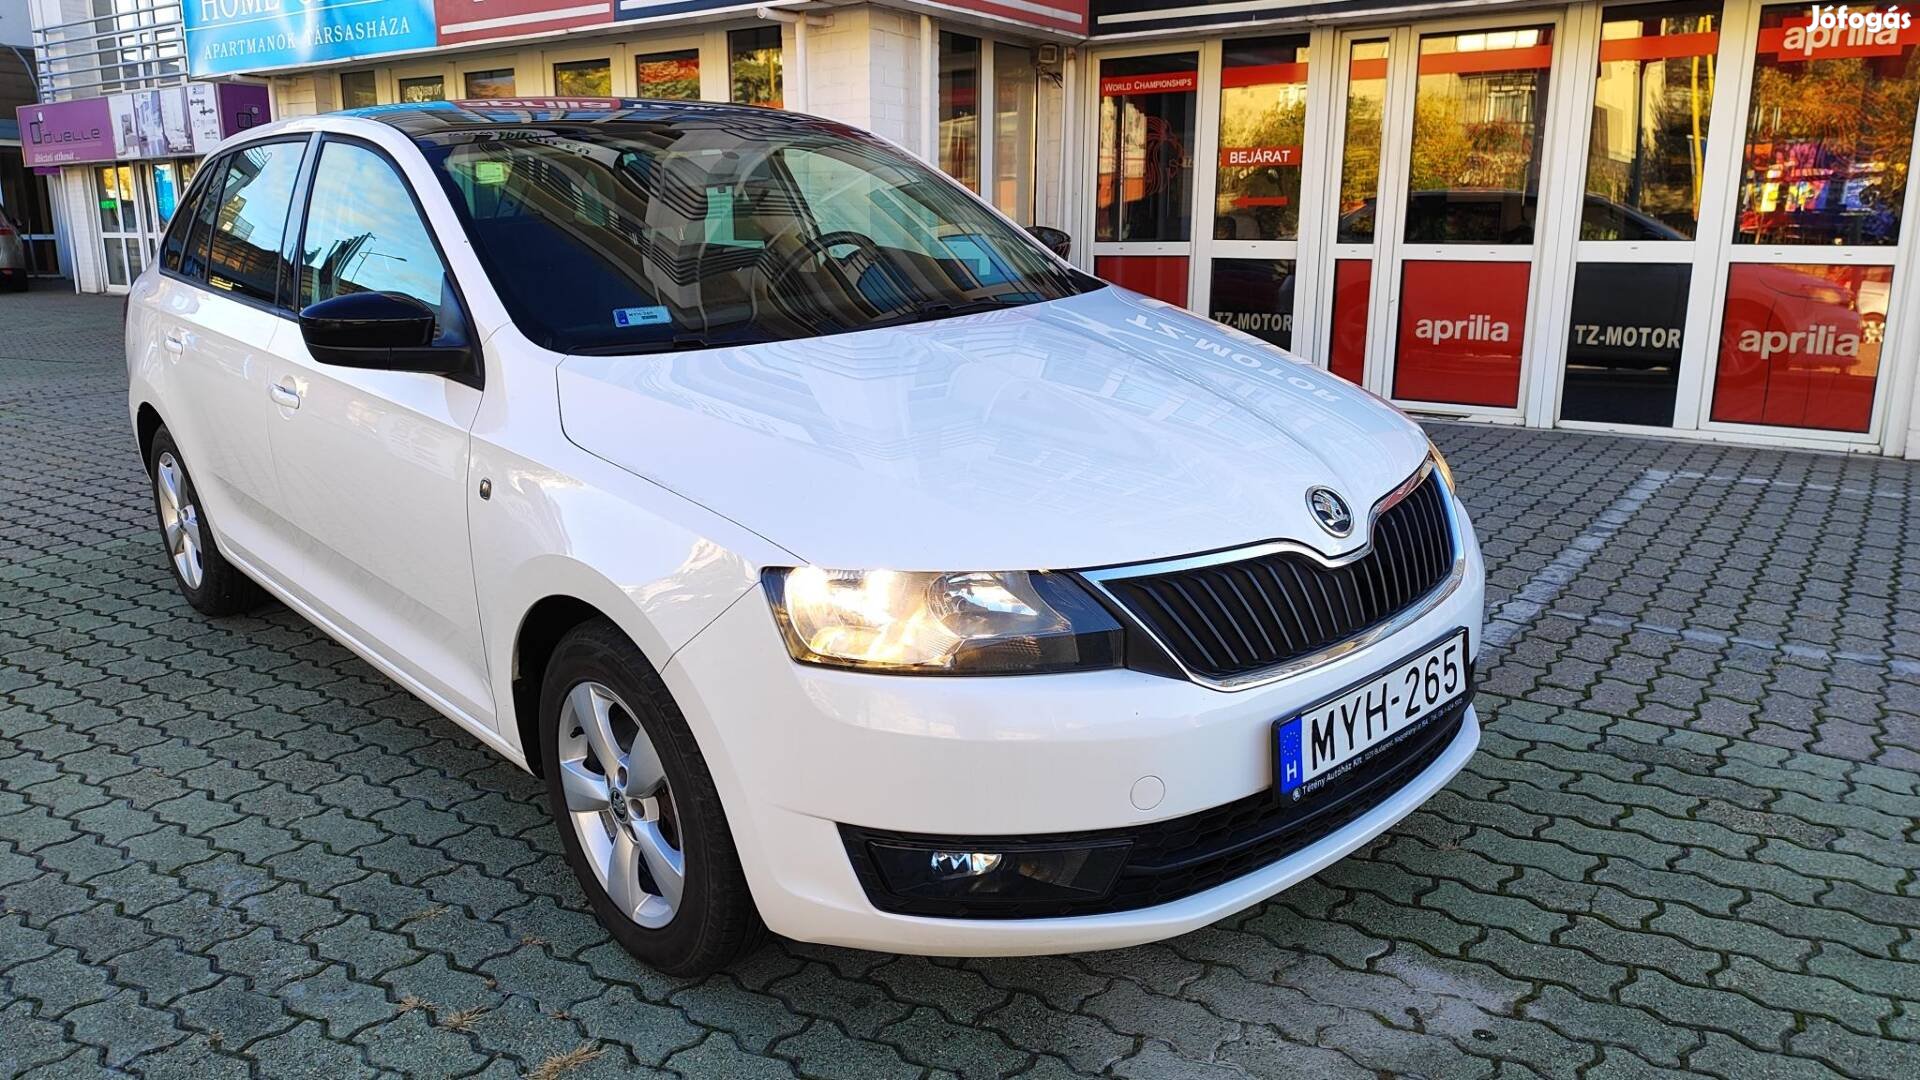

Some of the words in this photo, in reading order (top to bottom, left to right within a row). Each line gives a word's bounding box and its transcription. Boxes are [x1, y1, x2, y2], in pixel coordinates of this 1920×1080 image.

[201, 0, 281, 21] HO
[205, 32, 296, 60] APARTMANOK
[305, 16, 410, 46] TÁRSASHÁZA
[1229, 149, 1291, 164] BEJÁRAT
[1214, 311, 1293, 332] TZ-MOTOR
[1415, 315, 1509, 346] aprilia
[1574, 324, 1681, 349] TZ-MOTOR
[1738, 325, 1860, 359] aprilia
[1311, 644, 1458, 771] MYH-265
[1286, 760, 1298, 783] H
